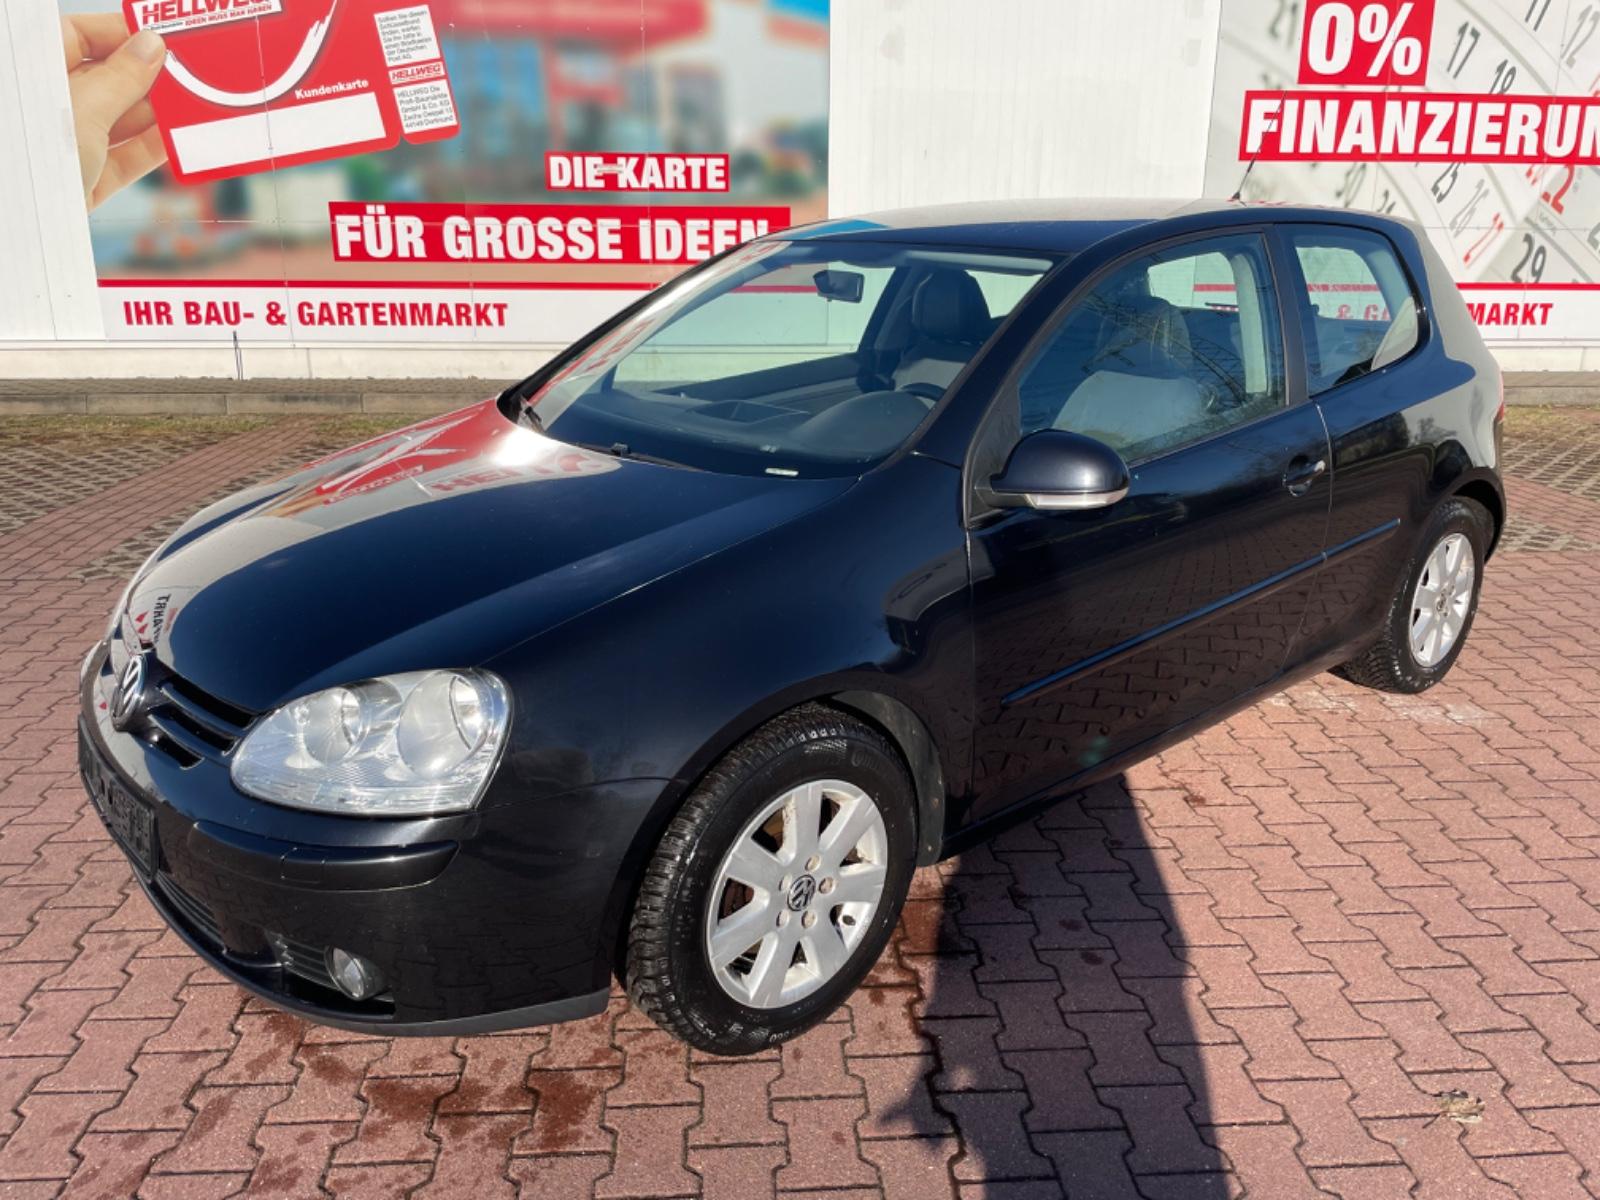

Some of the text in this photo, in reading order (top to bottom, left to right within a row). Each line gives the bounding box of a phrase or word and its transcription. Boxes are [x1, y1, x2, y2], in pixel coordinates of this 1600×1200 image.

[141, 0, 275, 24] HELLW
[1308, 1, 1422, 77] 0%
[1447, 21, 1480, 80] 17
[392, 63, 441, 80] HELLWEG
[295, 79, 369, 100] Kundenkarte
[549, 156, 725, 189] DIE KARTE
[334, 205, 427, 258] FÜR
[443, 216, 623, 259] GROSSE
[1510, 233, 1546, 284] 29
[123, 301, 508, 326] IHR BAU- & GARTENMARKT
